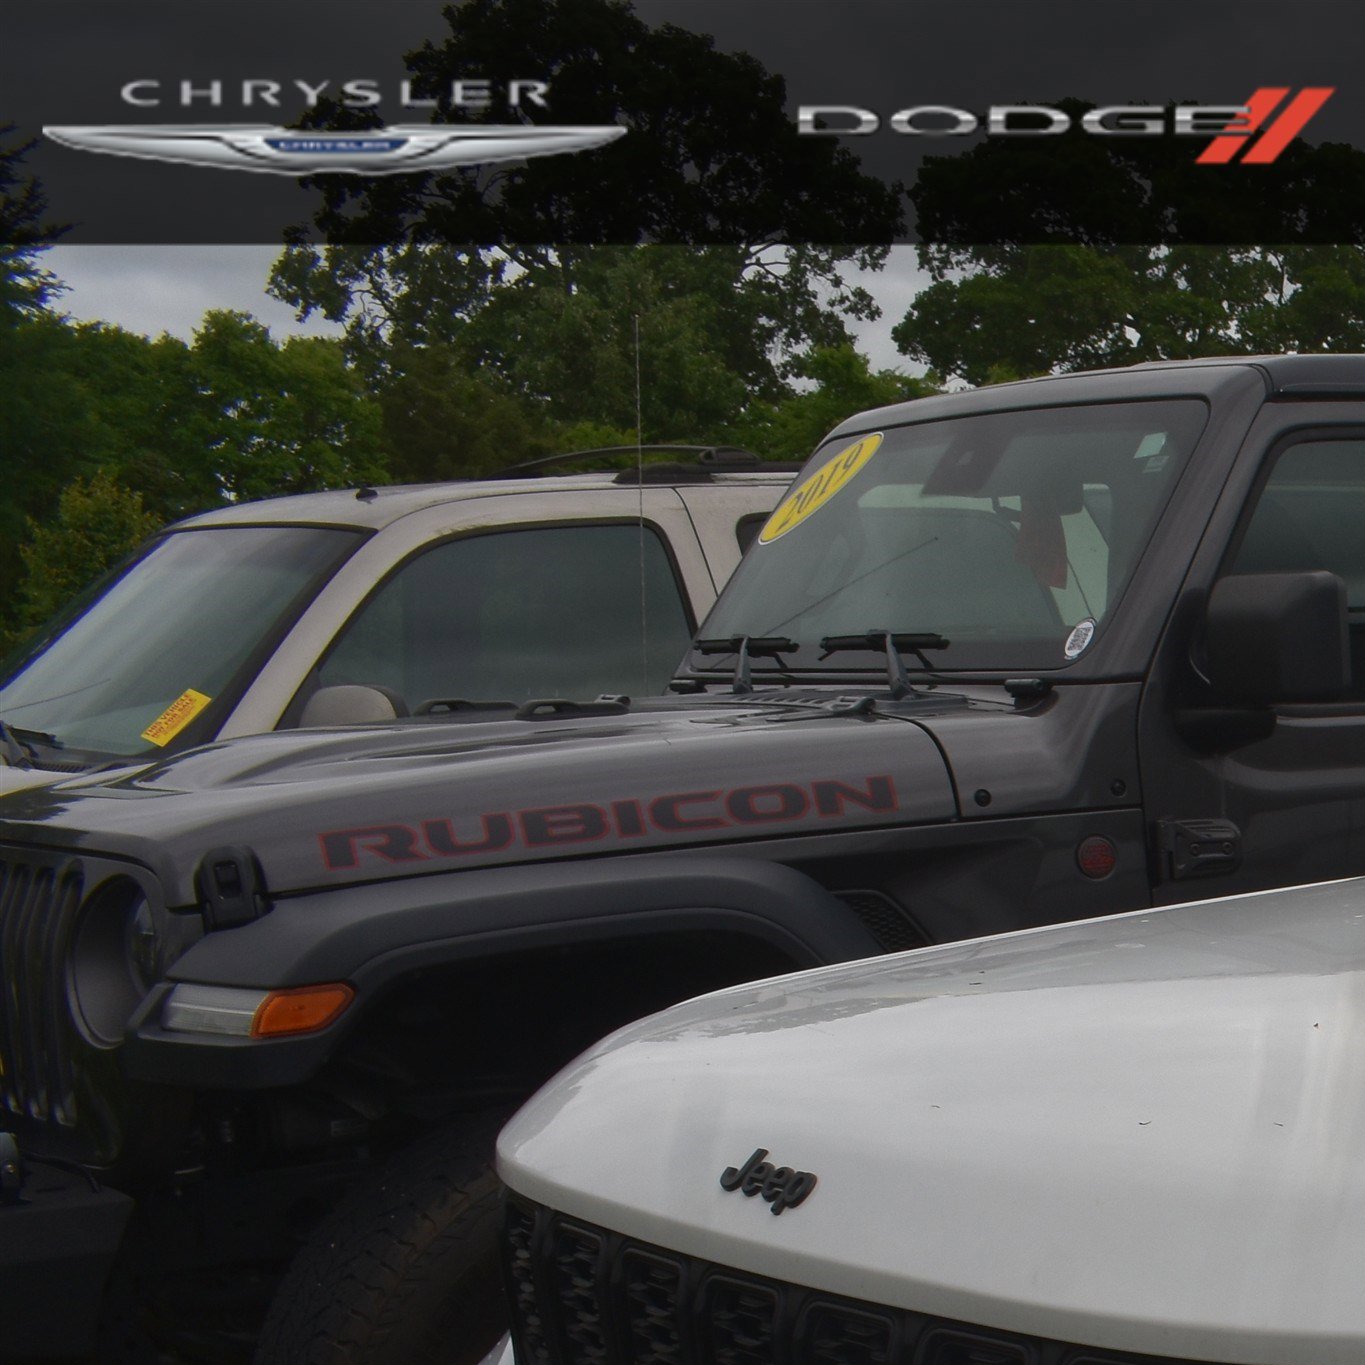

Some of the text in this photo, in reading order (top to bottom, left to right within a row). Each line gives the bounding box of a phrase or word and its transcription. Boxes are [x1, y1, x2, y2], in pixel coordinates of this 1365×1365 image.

[774, 442, 865, 535] 2019
[317, 774, 902, 873] RUBICON
[719, 1147, 818, 1217] Jeep
